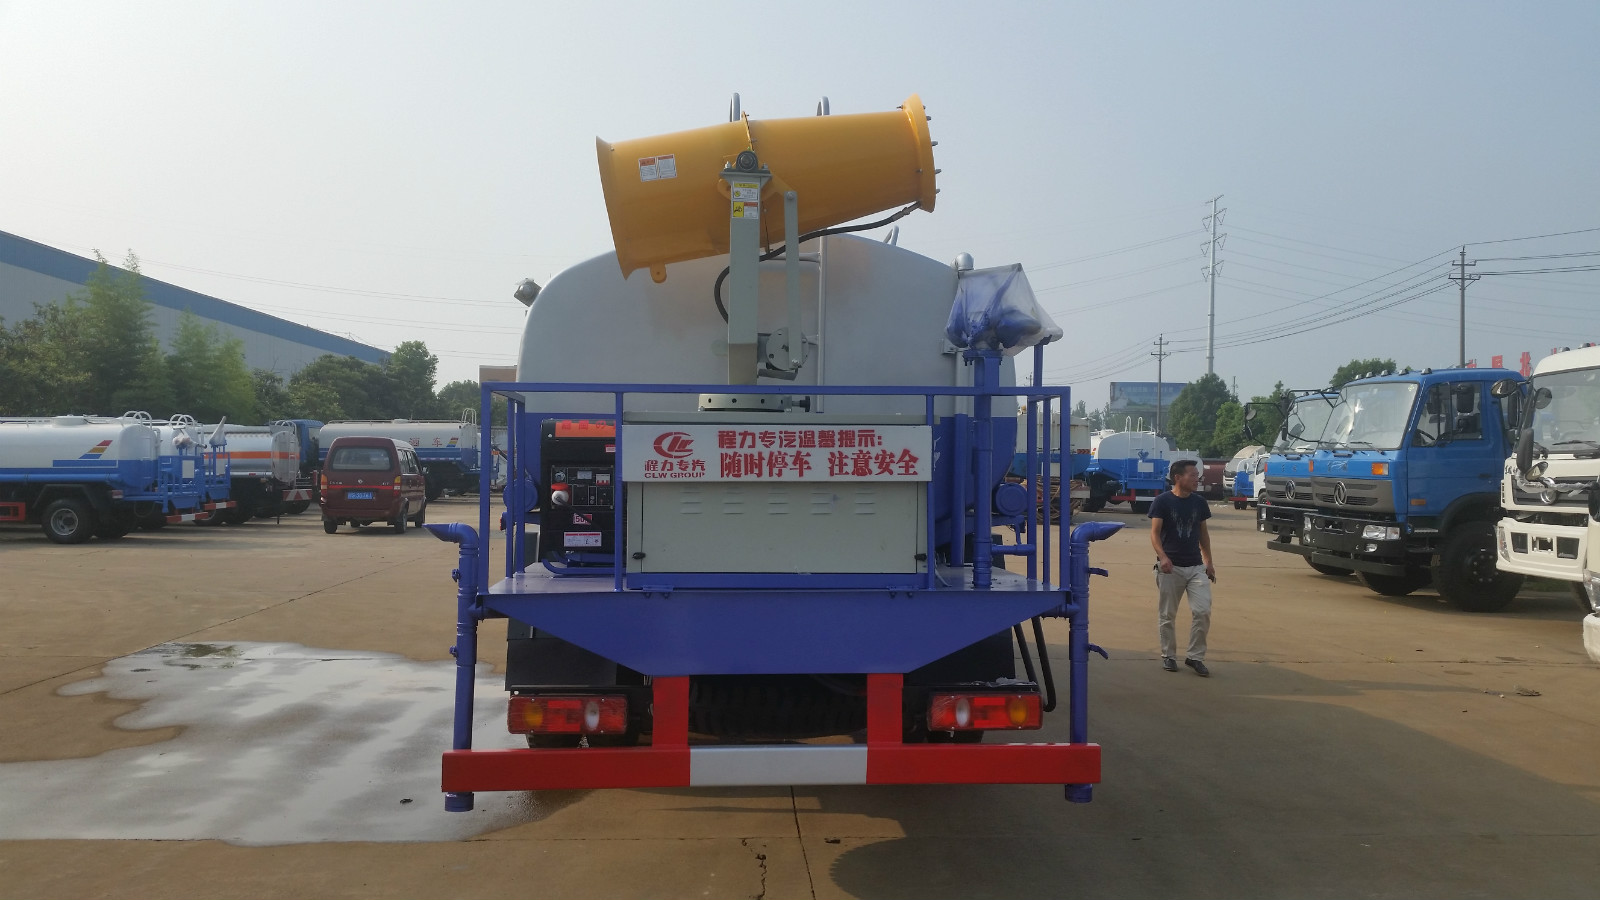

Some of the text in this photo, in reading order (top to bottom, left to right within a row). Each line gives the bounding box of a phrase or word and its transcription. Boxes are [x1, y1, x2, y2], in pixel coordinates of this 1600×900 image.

[644, 459, 706, 472] 程力专汽
[720, 448, 919, 478] 随时停车 注意安全
